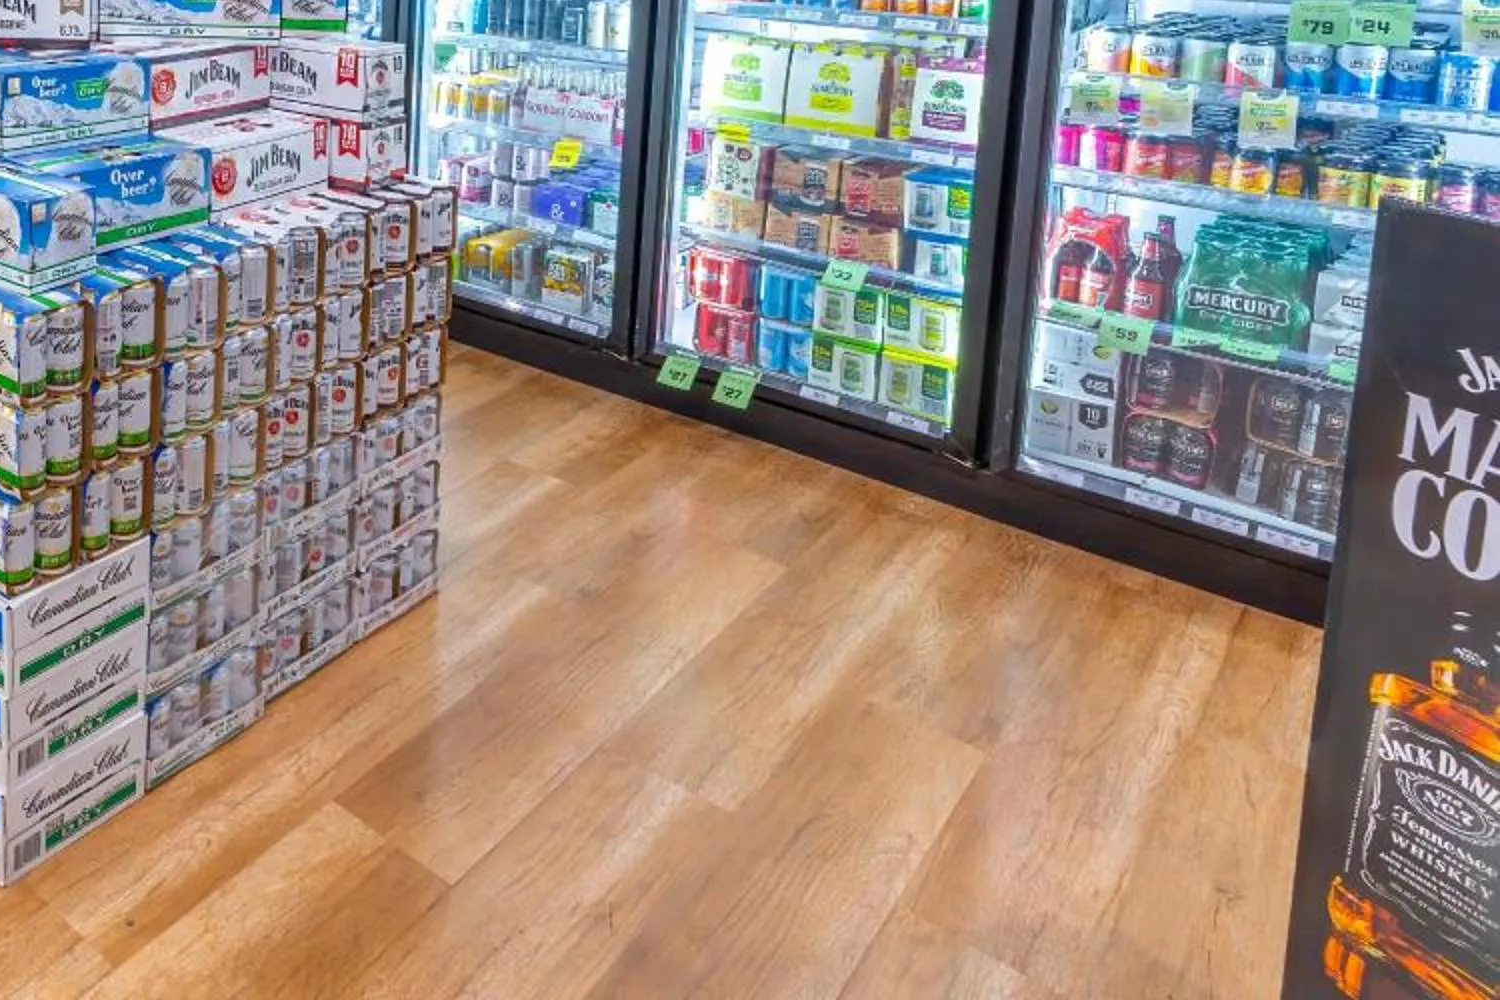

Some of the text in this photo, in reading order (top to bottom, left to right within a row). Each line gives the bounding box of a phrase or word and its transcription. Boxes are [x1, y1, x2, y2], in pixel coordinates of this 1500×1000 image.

[31, 76, 56, 90] Over
[185, 68, 208, 98] JIM
[208, 59, 242, 90] BEAM
[279, 47, 318, 91] BEAM
[109, 168, 145, 186] Over
[247, 155, 270, 186] JIM
[270, 144, 302, 174] BEAM
[120, 179, 158, 199] beer?
[126, 221, 158, 238] DRY
[1193, 289, 1284, 321] MERCURY
[1110, 325, 1139, 342] $59
[27, 555, 134, 631] Canadian Club
[63, 626, 107, 658] DRY
[25, 645, 132, 723] Canadian Club
[63, 714, 106, 748] DRY
[1379, 733, 1437, 773] JACK
[22, 736, 132, 818] Canadian Club
[61, 806, 102, 837] DRY
[1389, 829, 1494, 901] WHISKEY
